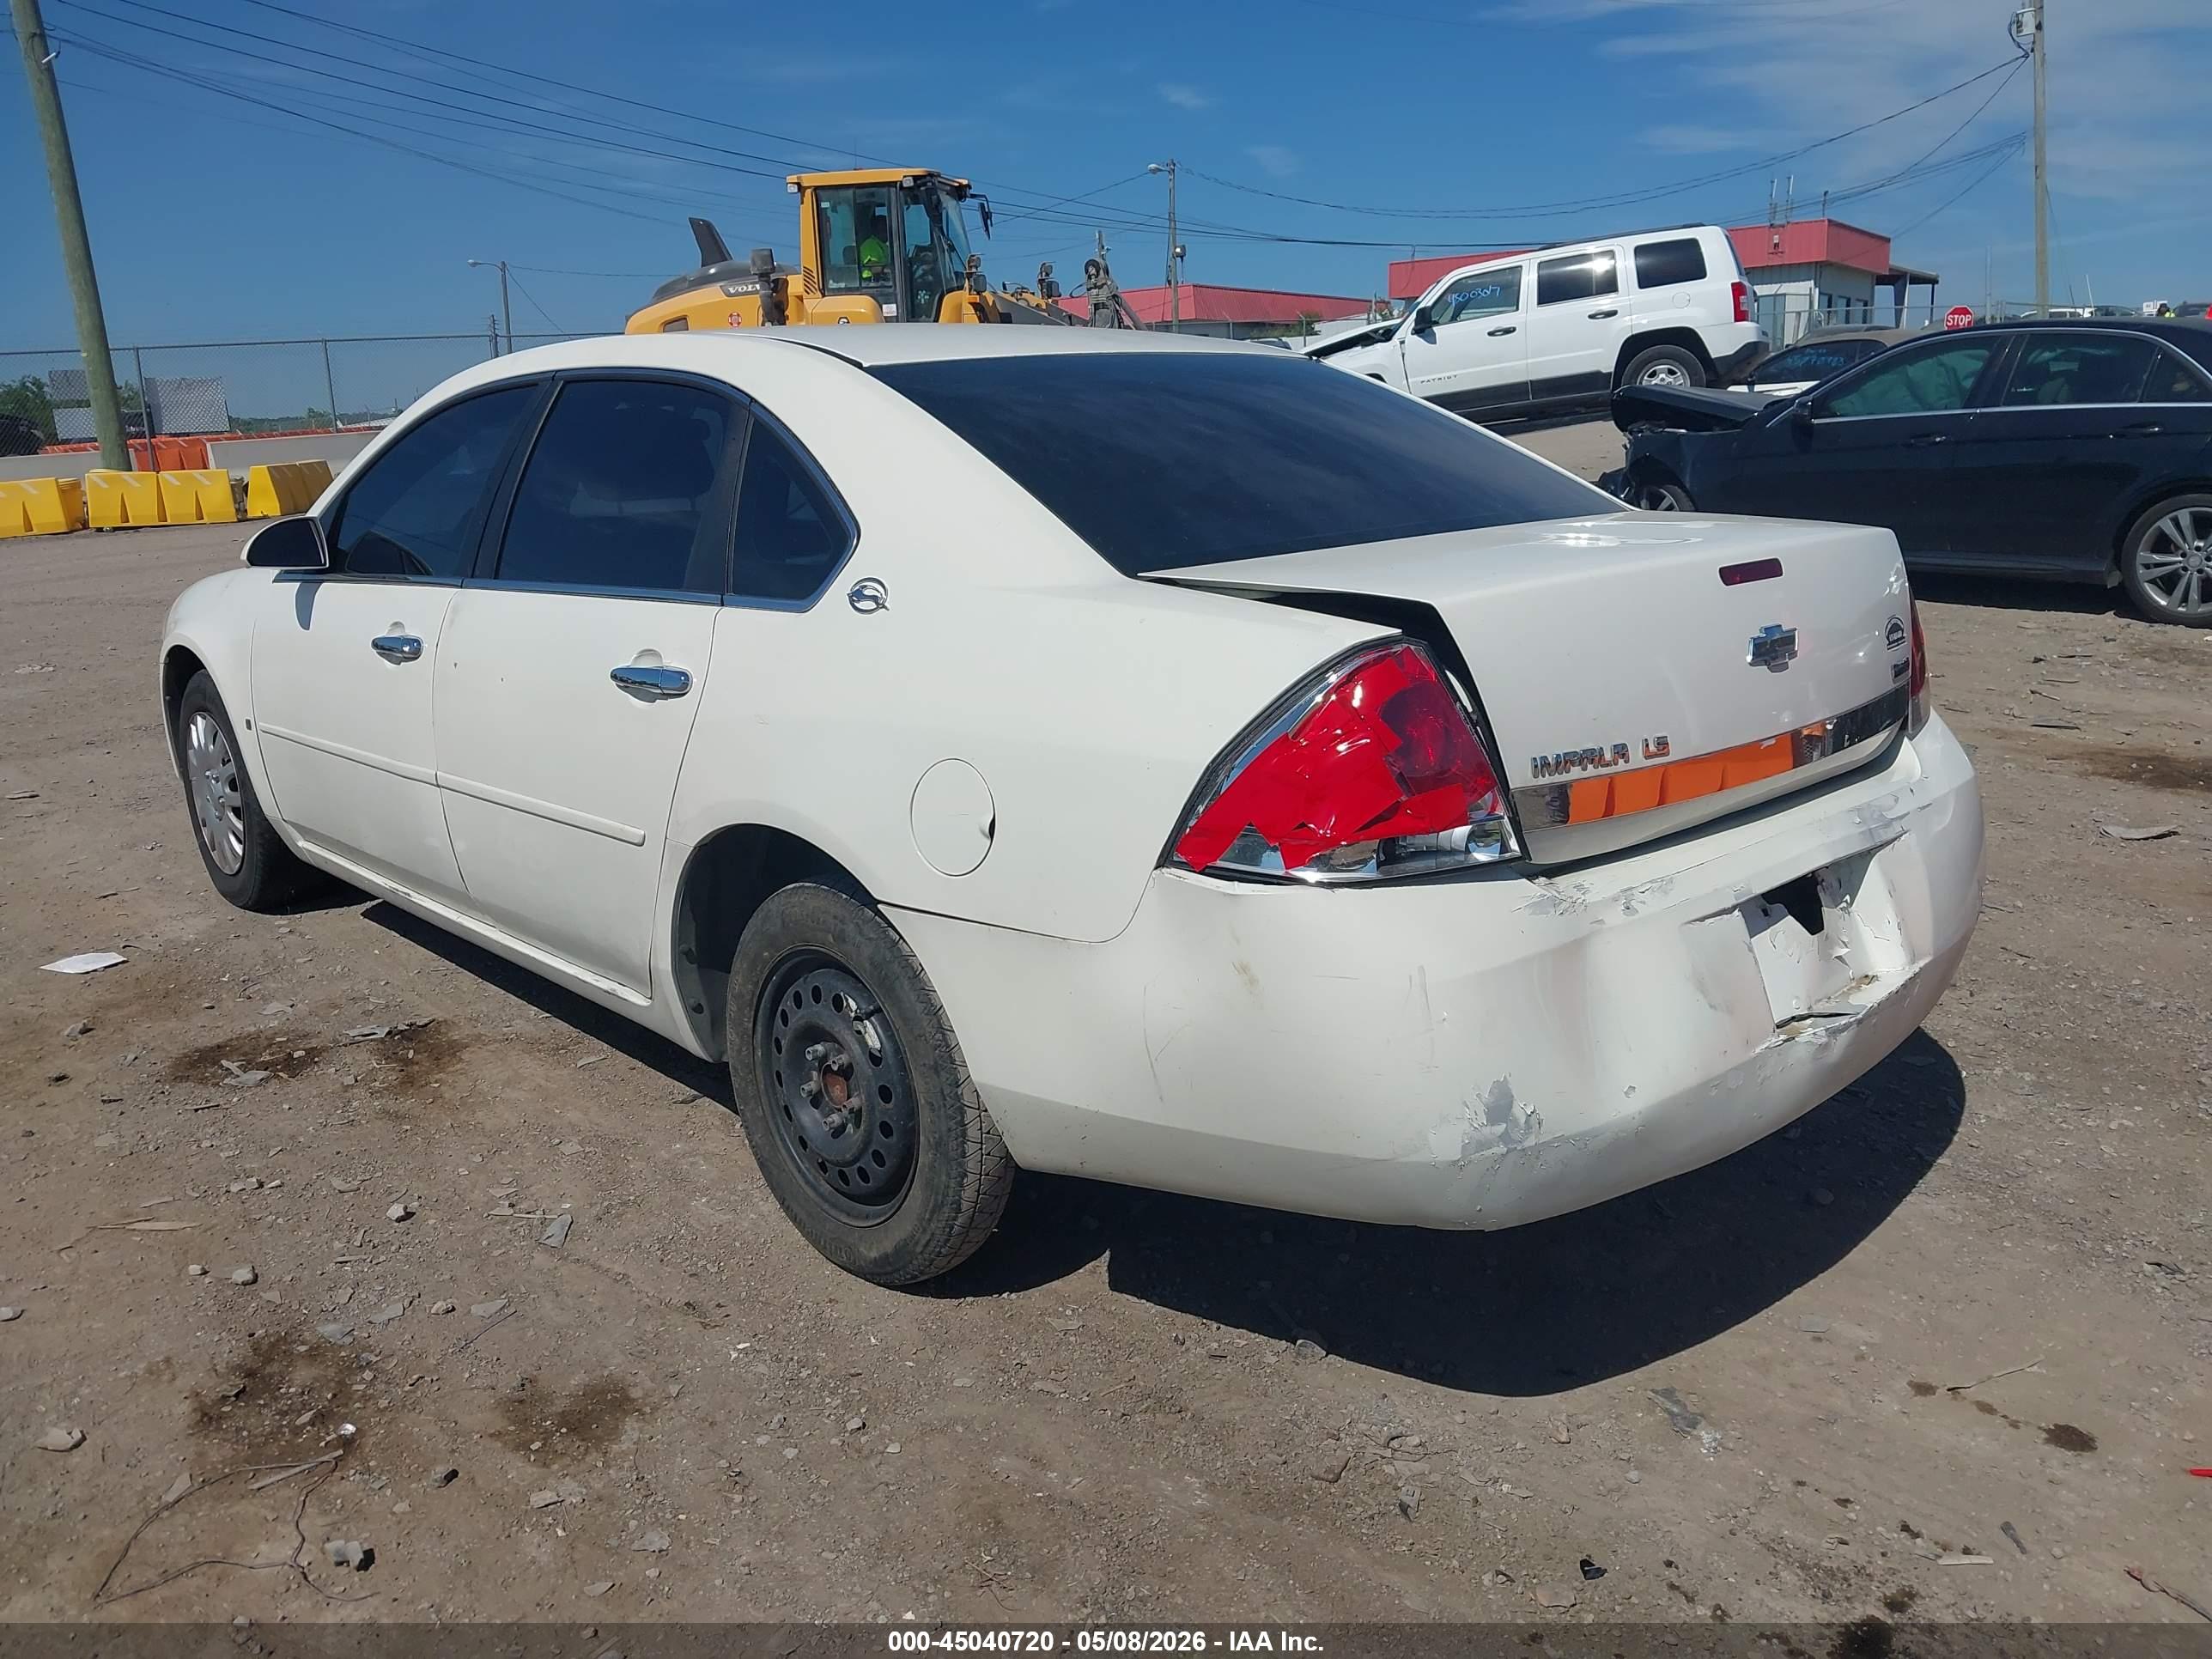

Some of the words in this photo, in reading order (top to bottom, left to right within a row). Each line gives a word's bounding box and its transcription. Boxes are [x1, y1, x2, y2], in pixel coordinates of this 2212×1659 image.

[1947, 314, 1972, 327] STOP
[1532, 743, 1630, 778] IMPALA
[1642, 735, 1669, 760] LS
